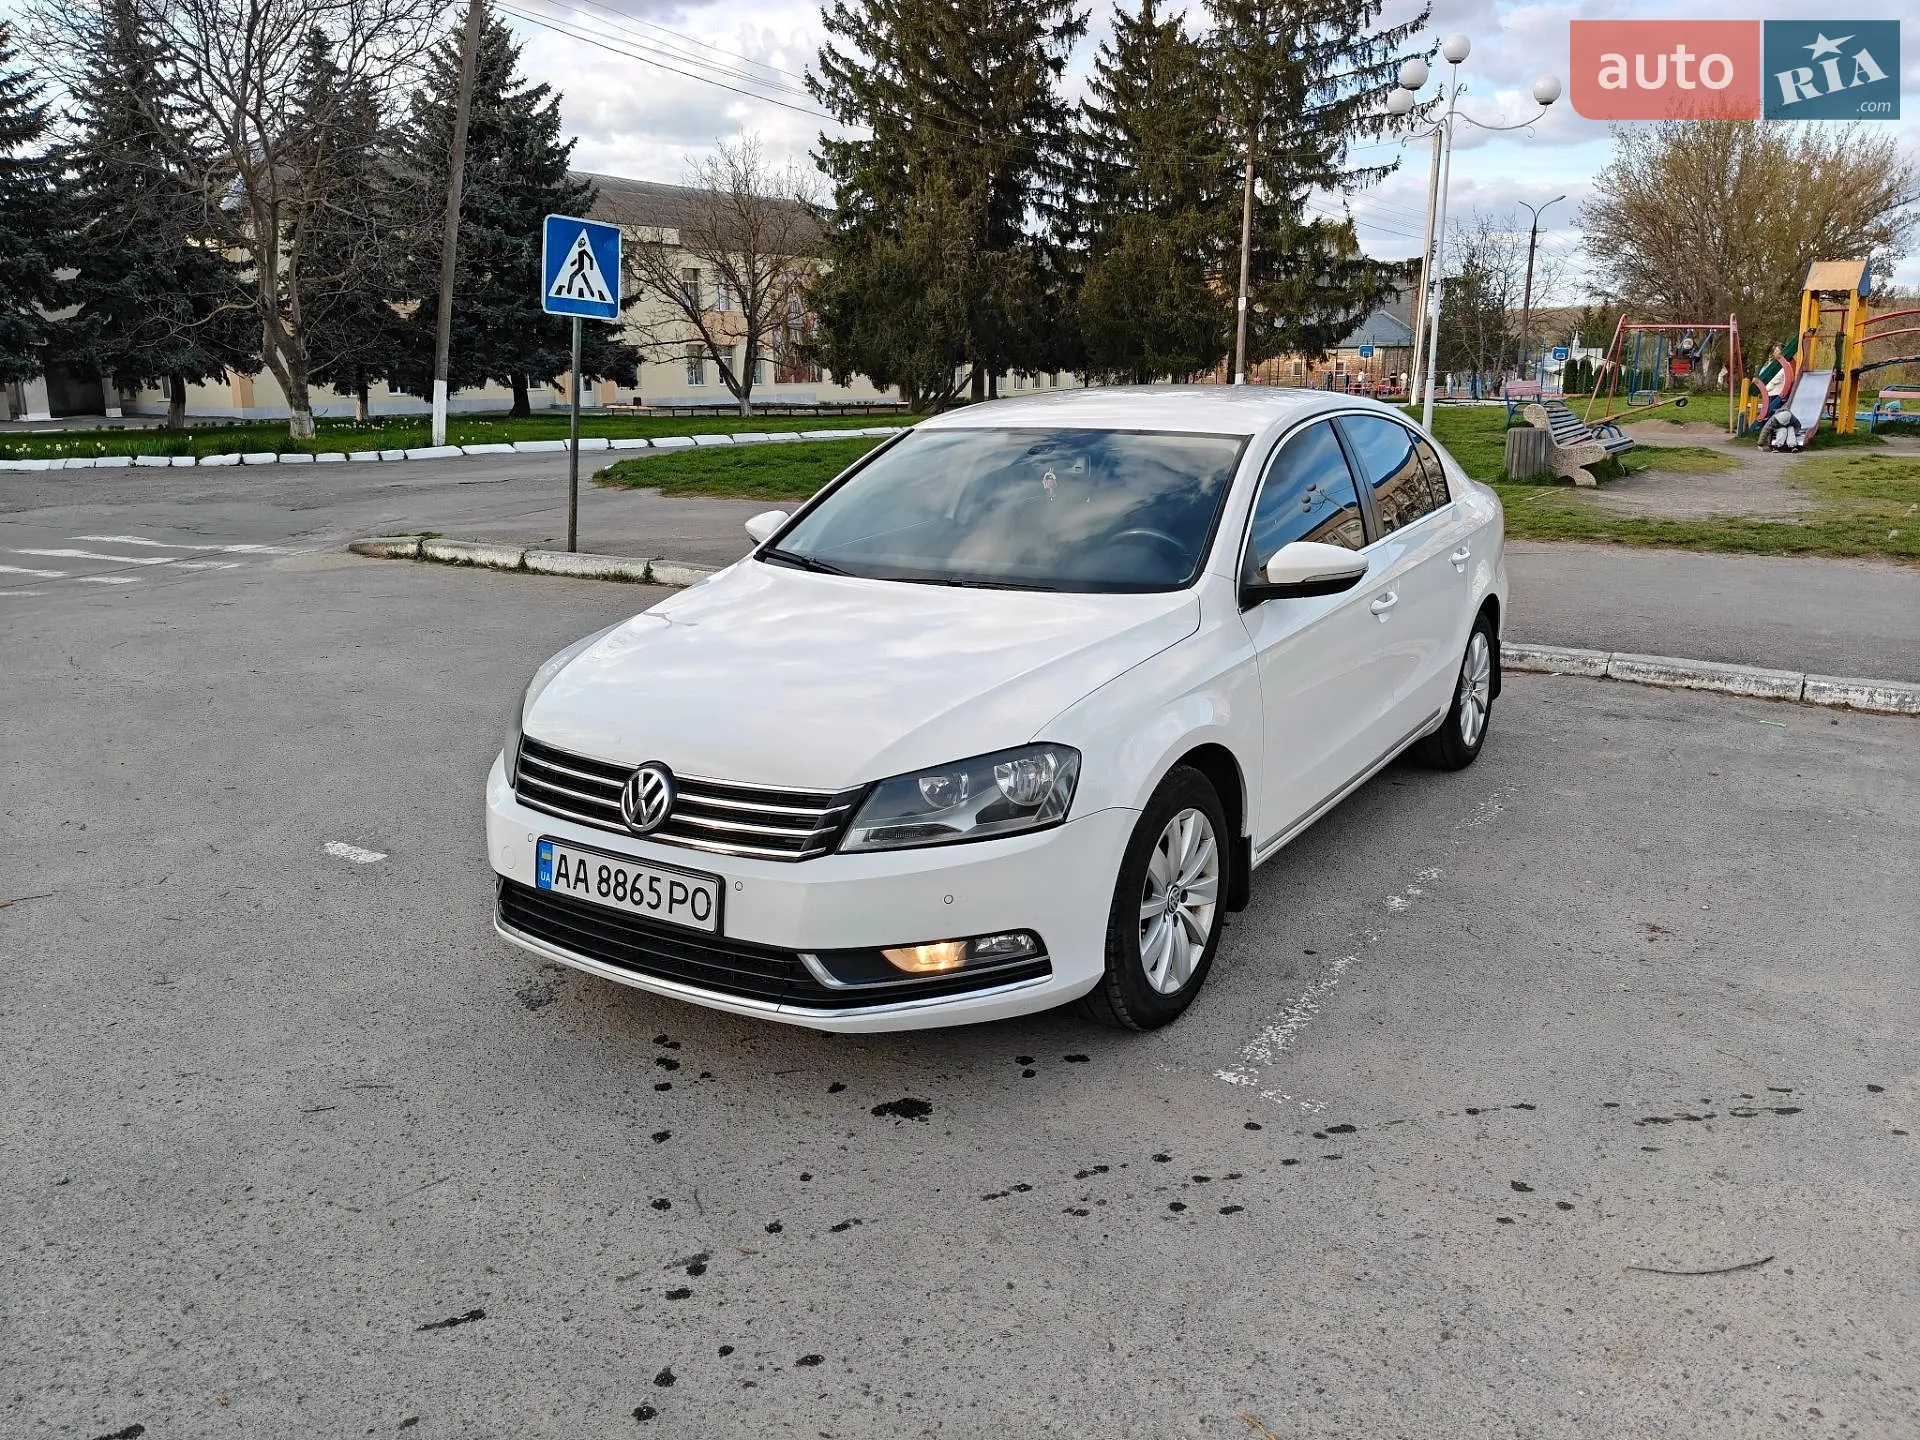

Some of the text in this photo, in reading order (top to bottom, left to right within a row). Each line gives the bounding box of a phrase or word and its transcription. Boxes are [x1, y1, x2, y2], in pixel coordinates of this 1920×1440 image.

[540, 870, 551, 883] UA
[554, 853, 712, 921] AA 8865 PO
